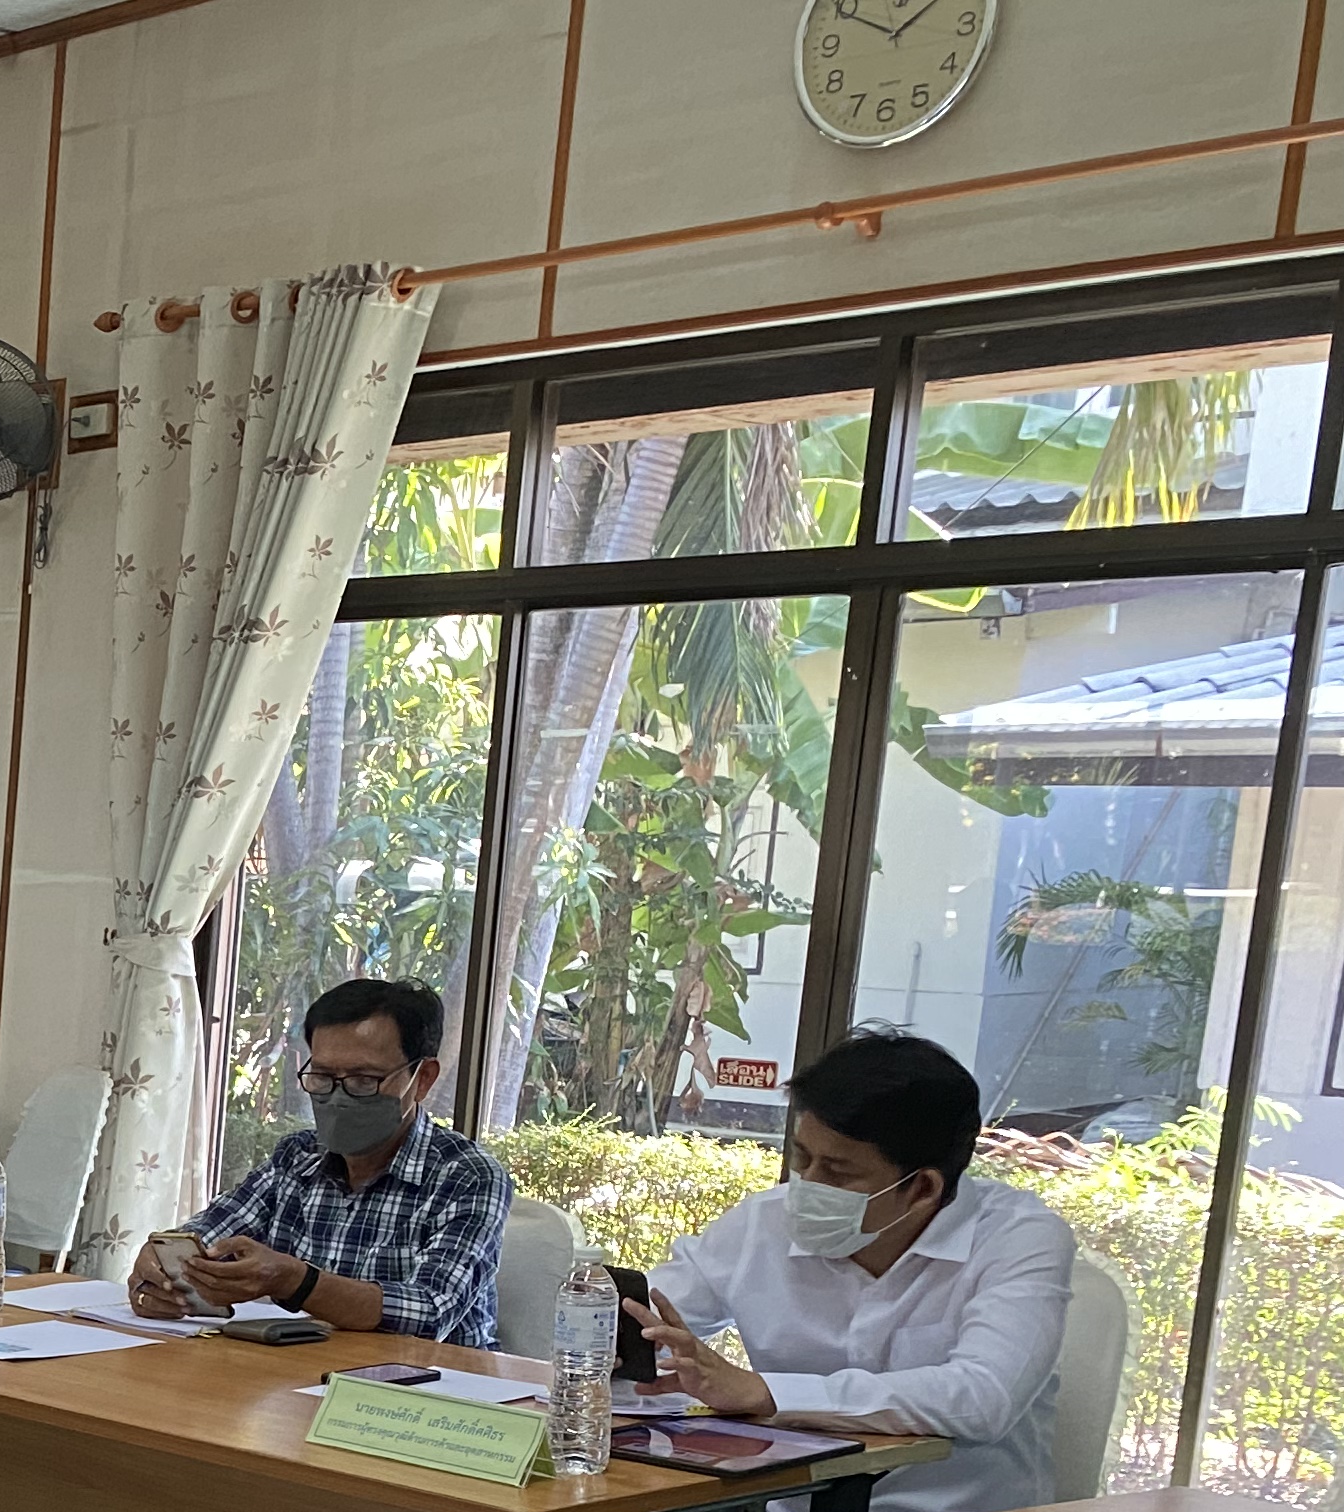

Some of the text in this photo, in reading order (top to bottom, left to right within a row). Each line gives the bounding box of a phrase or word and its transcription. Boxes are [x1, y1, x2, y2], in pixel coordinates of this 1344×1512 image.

[956, 11, 977, 36] 3
[821, 34, 840, 58] 9
[939, 51, 958, 75] 4
[825, 69, 844, 94] 8
[850, 93, 868, 118] 7
[911, 83, 930, 108] 5
[876, 98, 896, 123] 6
[718, 1074, 764, 1087] SLIDE
